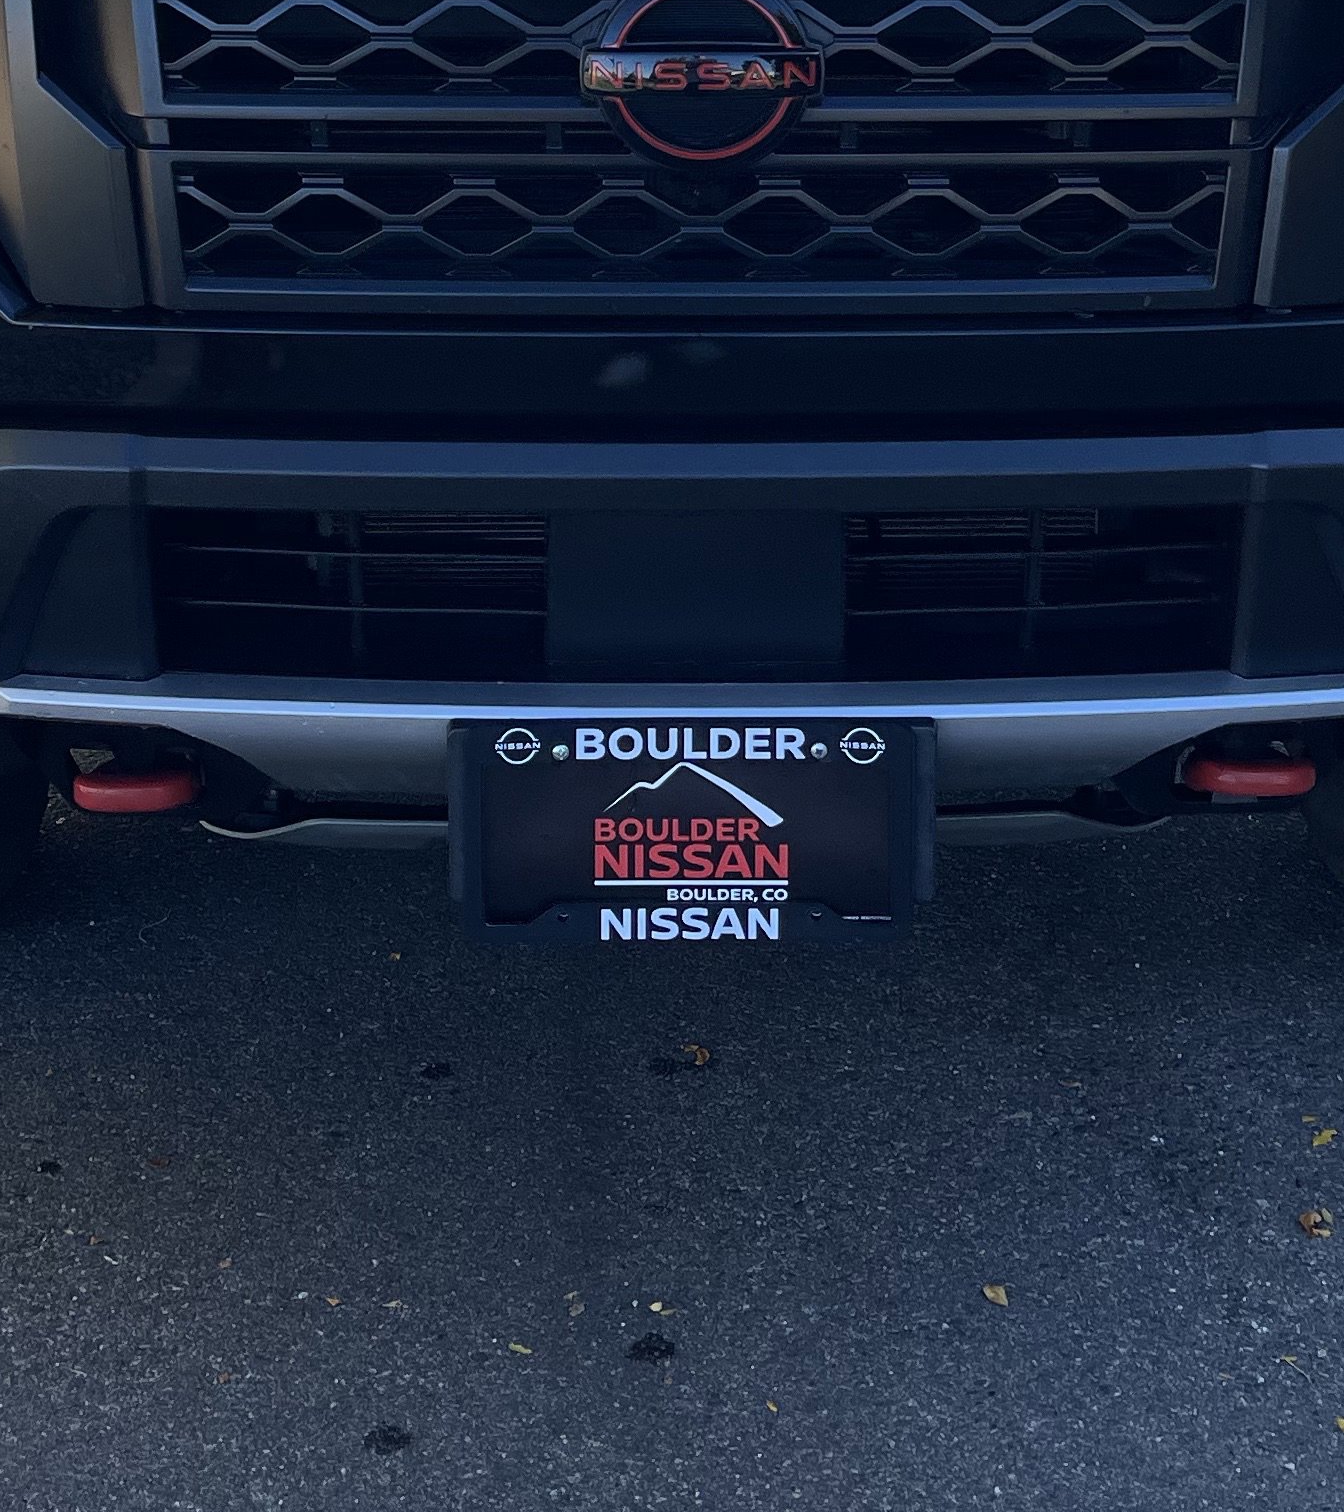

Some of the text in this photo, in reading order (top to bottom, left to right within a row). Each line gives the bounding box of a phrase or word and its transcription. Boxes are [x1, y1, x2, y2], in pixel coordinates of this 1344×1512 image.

[590, 60, 817, 90] NISSAN
[494, 727, 886, 761] NISSAN BOULDER NISSAN
[594, 818, 760, 842] BOULDER
[593, 844, 789, 879] NISSAN
[666, 888, 789, 903] BOULDER, CO
[599, 908, 780, 941] NISSAN
